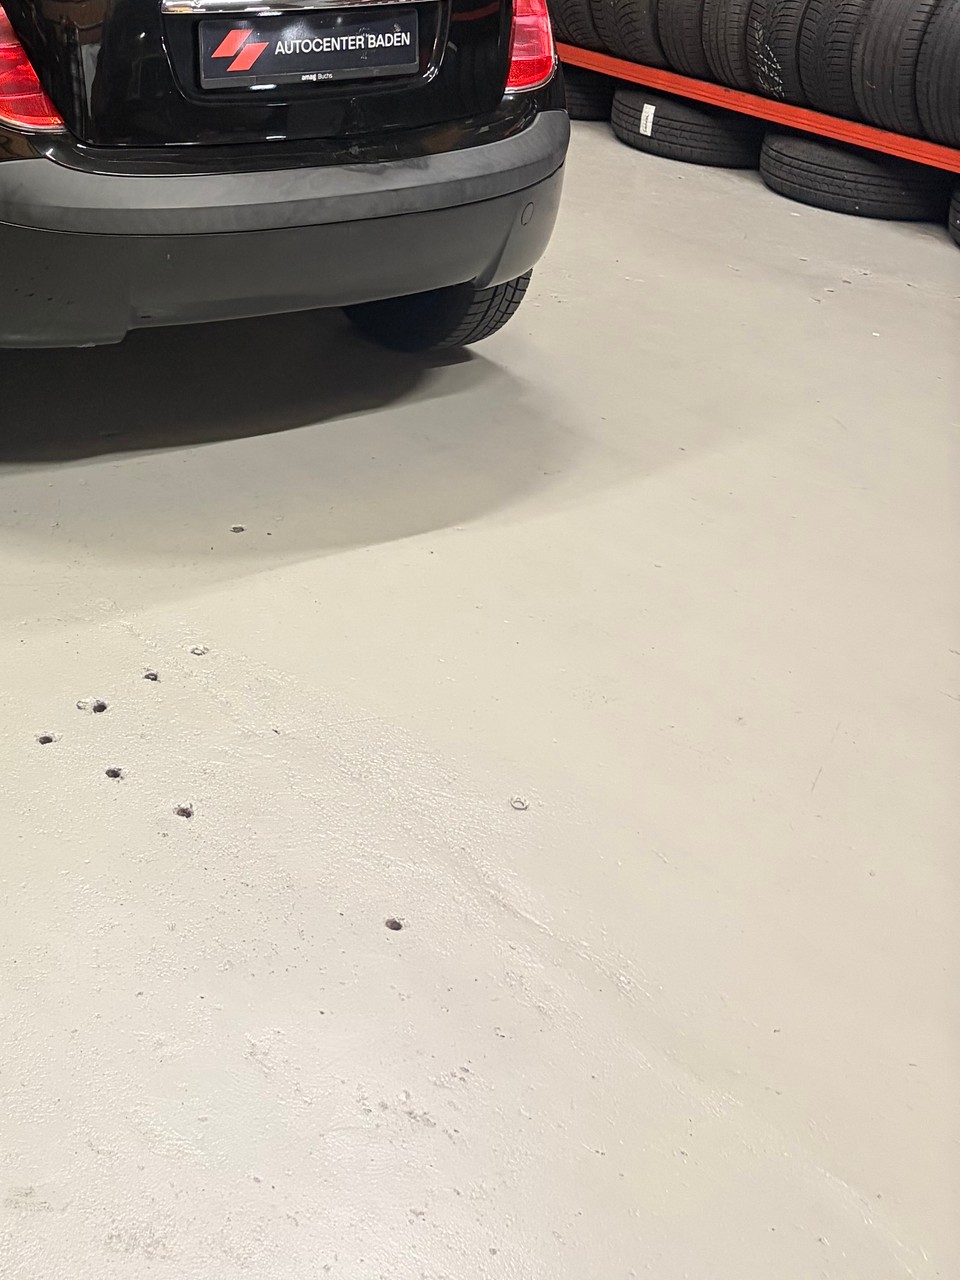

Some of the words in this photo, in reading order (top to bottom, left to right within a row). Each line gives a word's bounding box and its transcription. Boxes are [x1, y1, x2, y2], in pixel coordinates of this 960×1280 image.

[274, 35, 365, 55] AUTOCENTER
[367, 32, 411, 49] BADEN
[301, 73, 317, 81] amag
